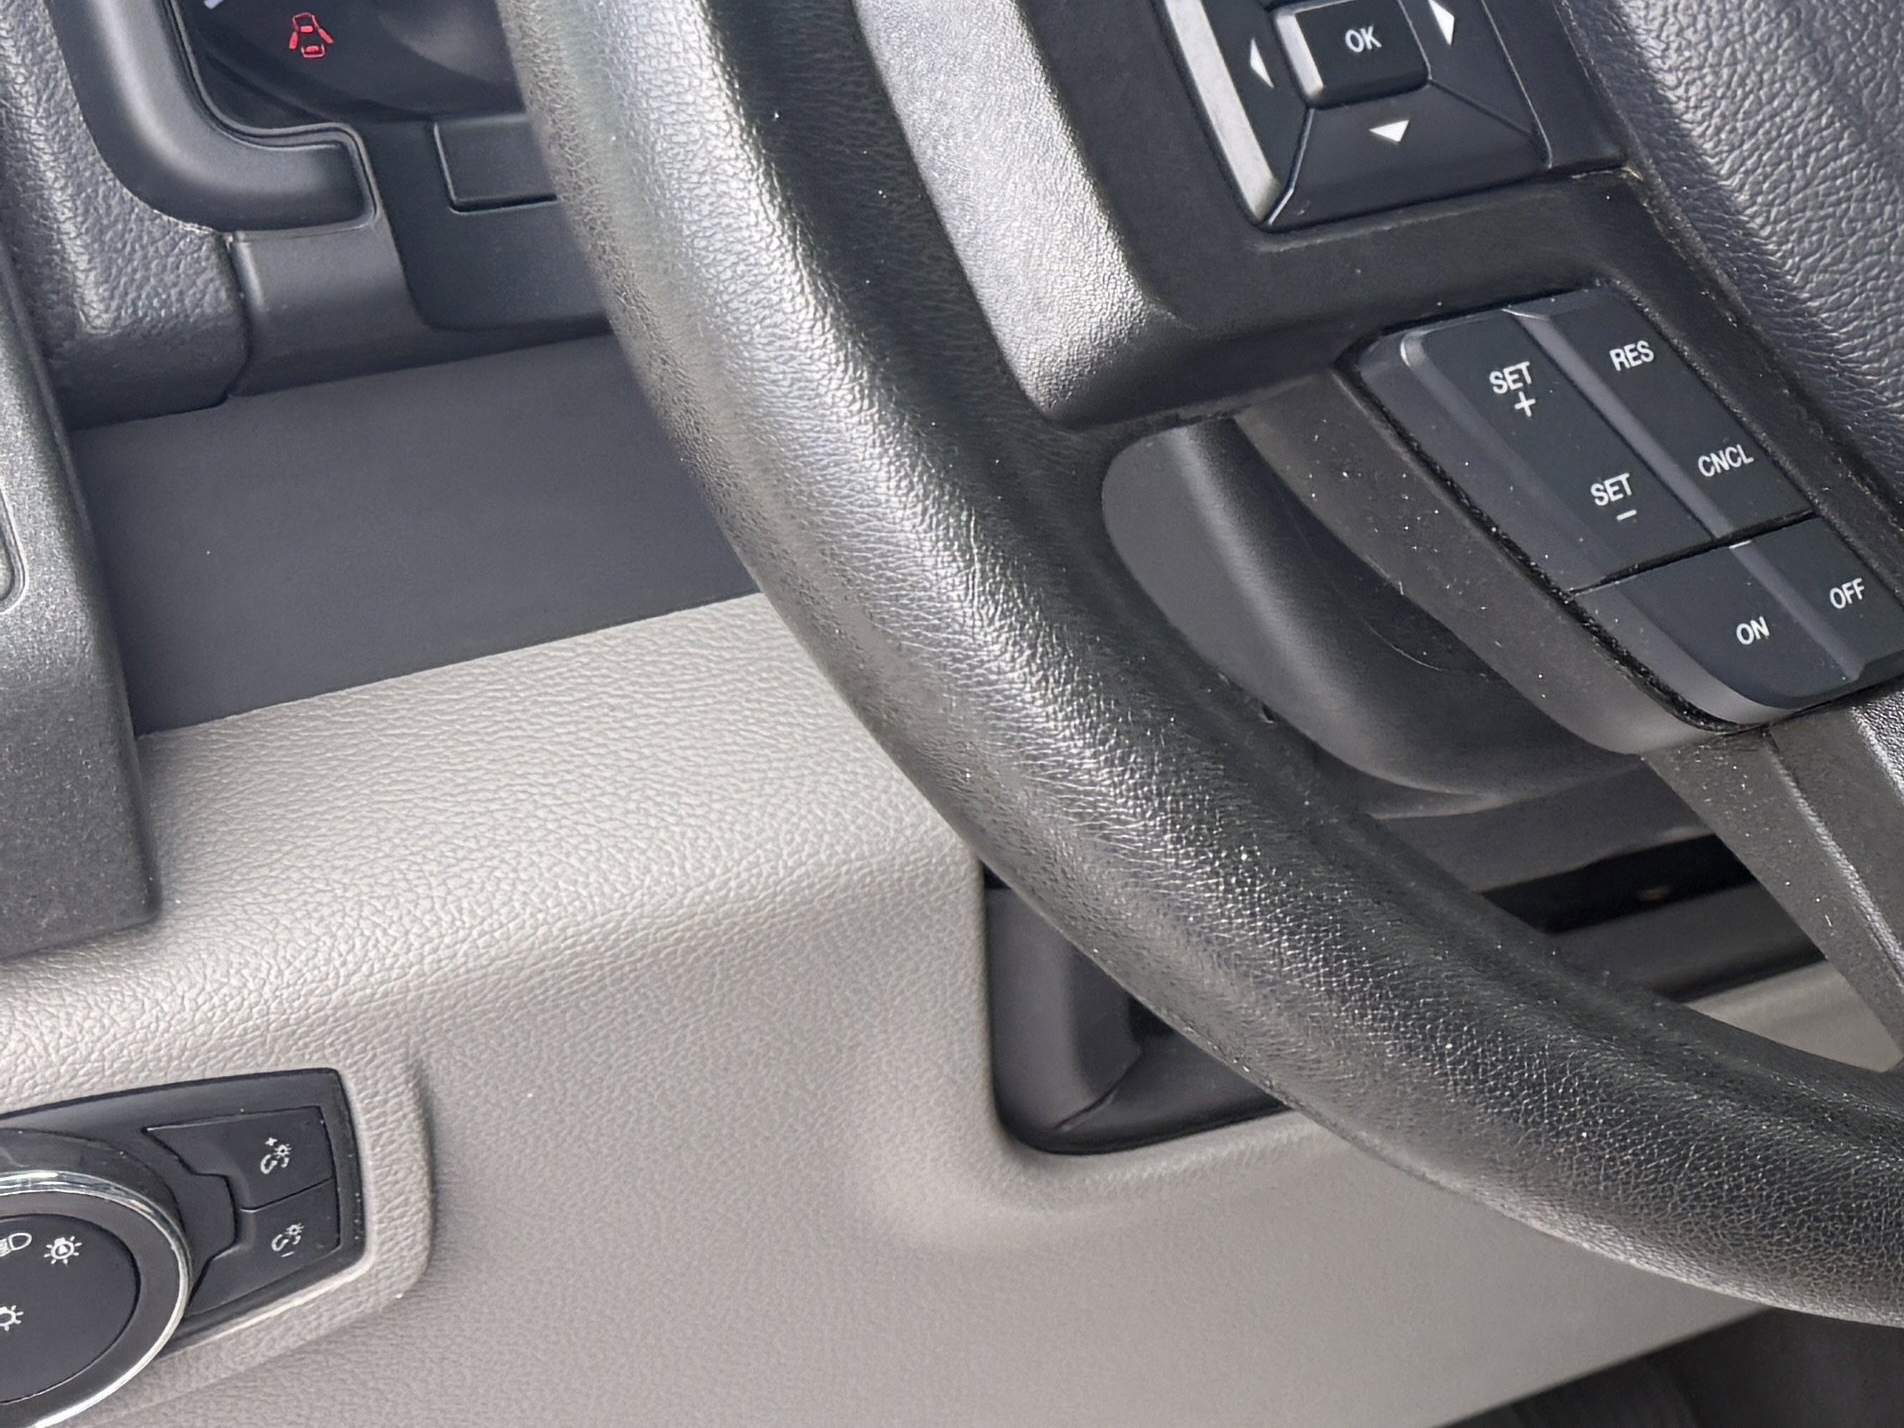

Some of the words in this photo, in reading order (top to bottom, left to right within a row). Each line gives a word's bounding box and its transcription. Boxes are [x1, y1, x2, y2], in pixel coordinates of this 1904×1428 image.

[1343, 25, 1383, 55] OK
[1609, 340, 1655, 372] RES
[1490, 360, 1533, 395] SET
[1698, 443, 1754, 478] CNCL
[1590, 472, 1634, 507] SET
[1830, 578, 1868, 610] OFF
[1736, 616, 1770, 645] ON
